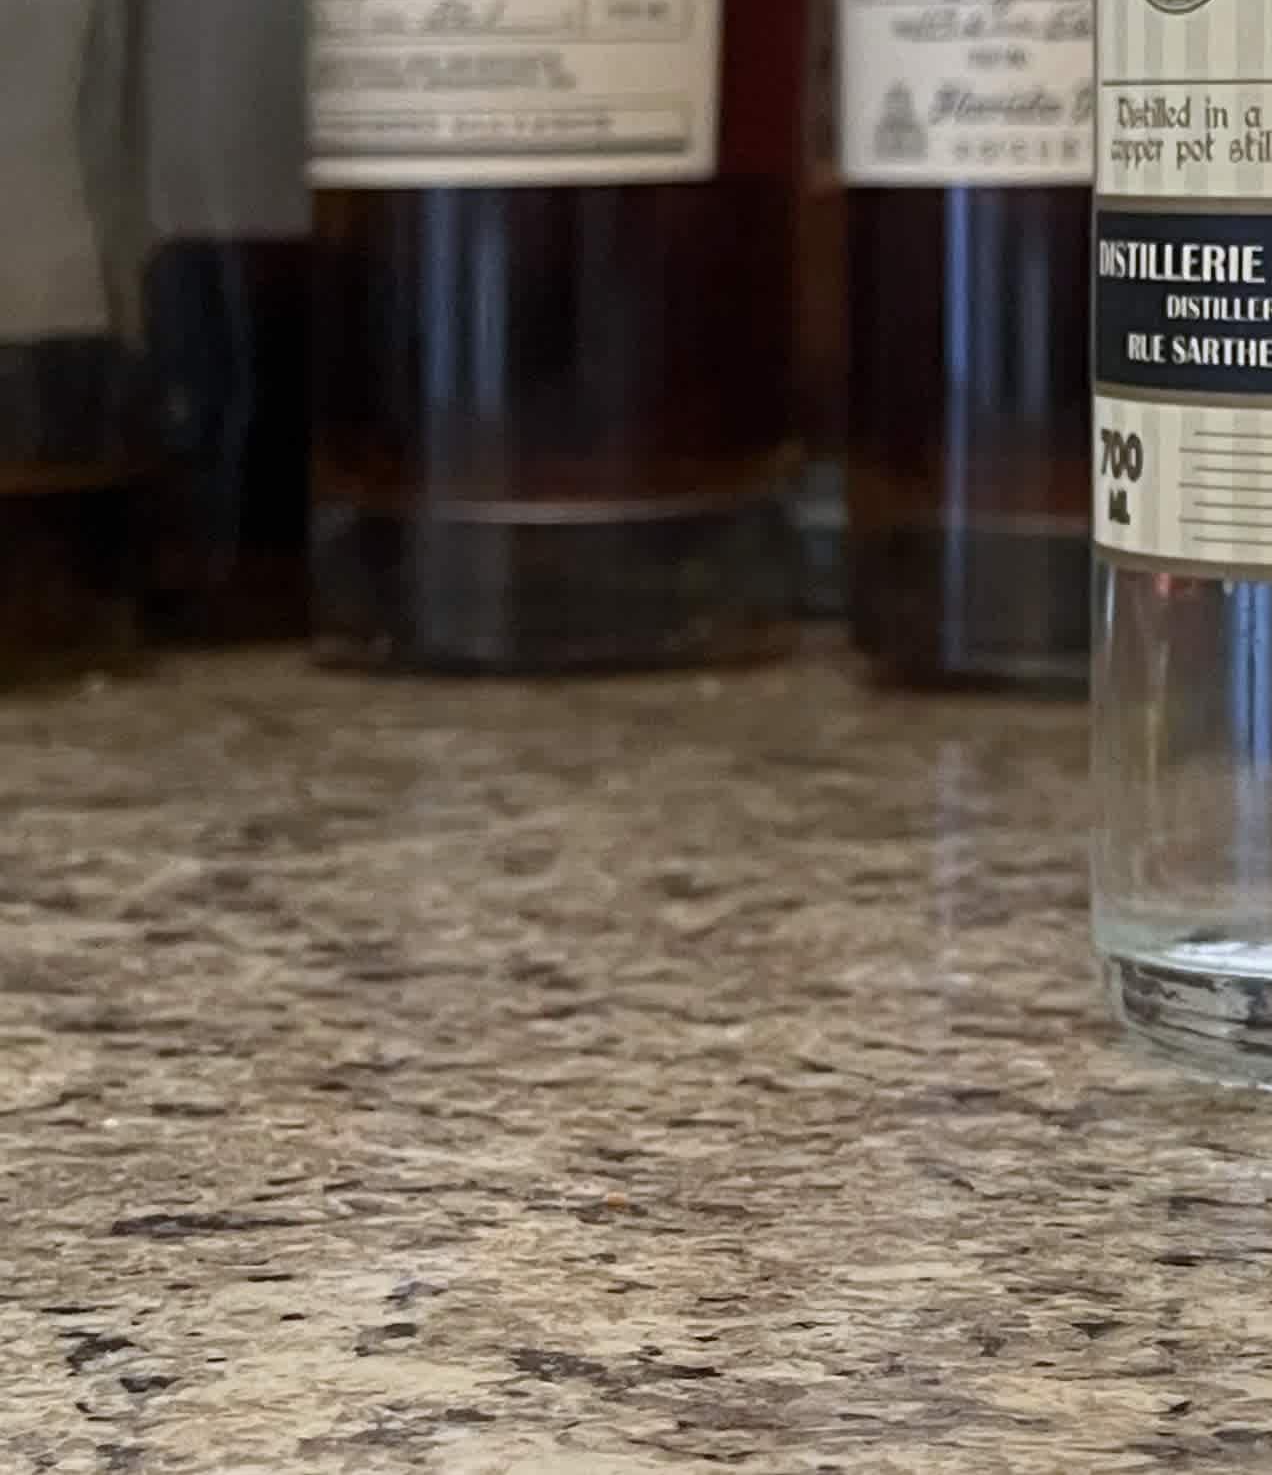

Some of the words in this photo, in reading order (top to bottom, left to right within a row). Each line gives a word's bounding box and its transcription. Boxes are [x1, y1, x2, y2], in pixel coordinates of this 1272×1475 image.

[1204, 95, 1230, 130] in
[1244, 105, 1263, 129] a
[1175, 131, 1216, 171] pot
[1099, 238, 1267, 284] DISTILLERIE
[1100, 427, 1145, 483] 700
